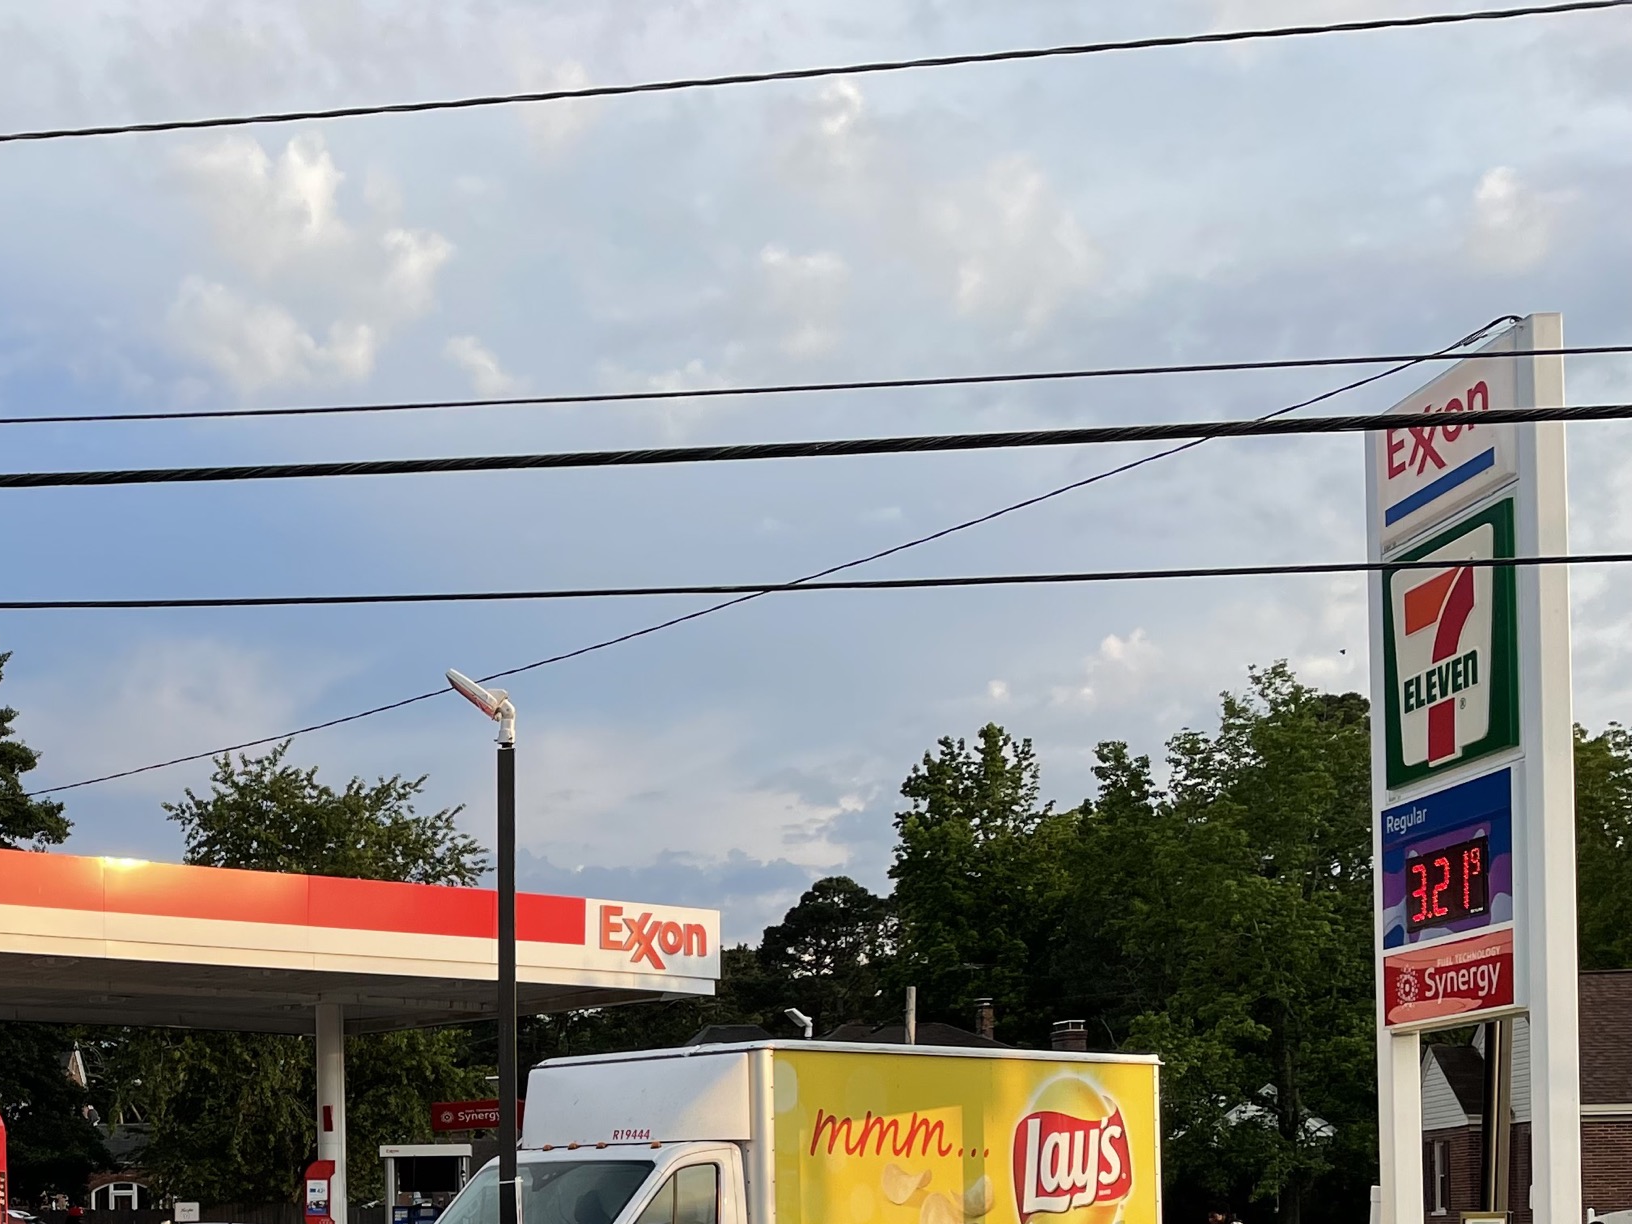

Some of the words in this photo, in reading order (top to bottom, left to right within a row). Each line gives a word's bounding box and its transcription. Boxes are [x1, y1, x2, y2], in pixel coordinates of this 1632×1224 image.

[1386, 380, 1489, 480] Exxon
[1386, 806, 1428, 835] Regular
[599, 904, 708, 970] Exxon
[1437, 954, 1453, 968] FUEL
[1455, 946, 1501, 966] TECHNOLOGY
[1424, 962, 1501, 1004] Synergy
[612, 1129, 651, 1141] R19444
[809, 1108, 991, 1159] mmm...
[1022, 1116, 1123, 1215] Lay's
